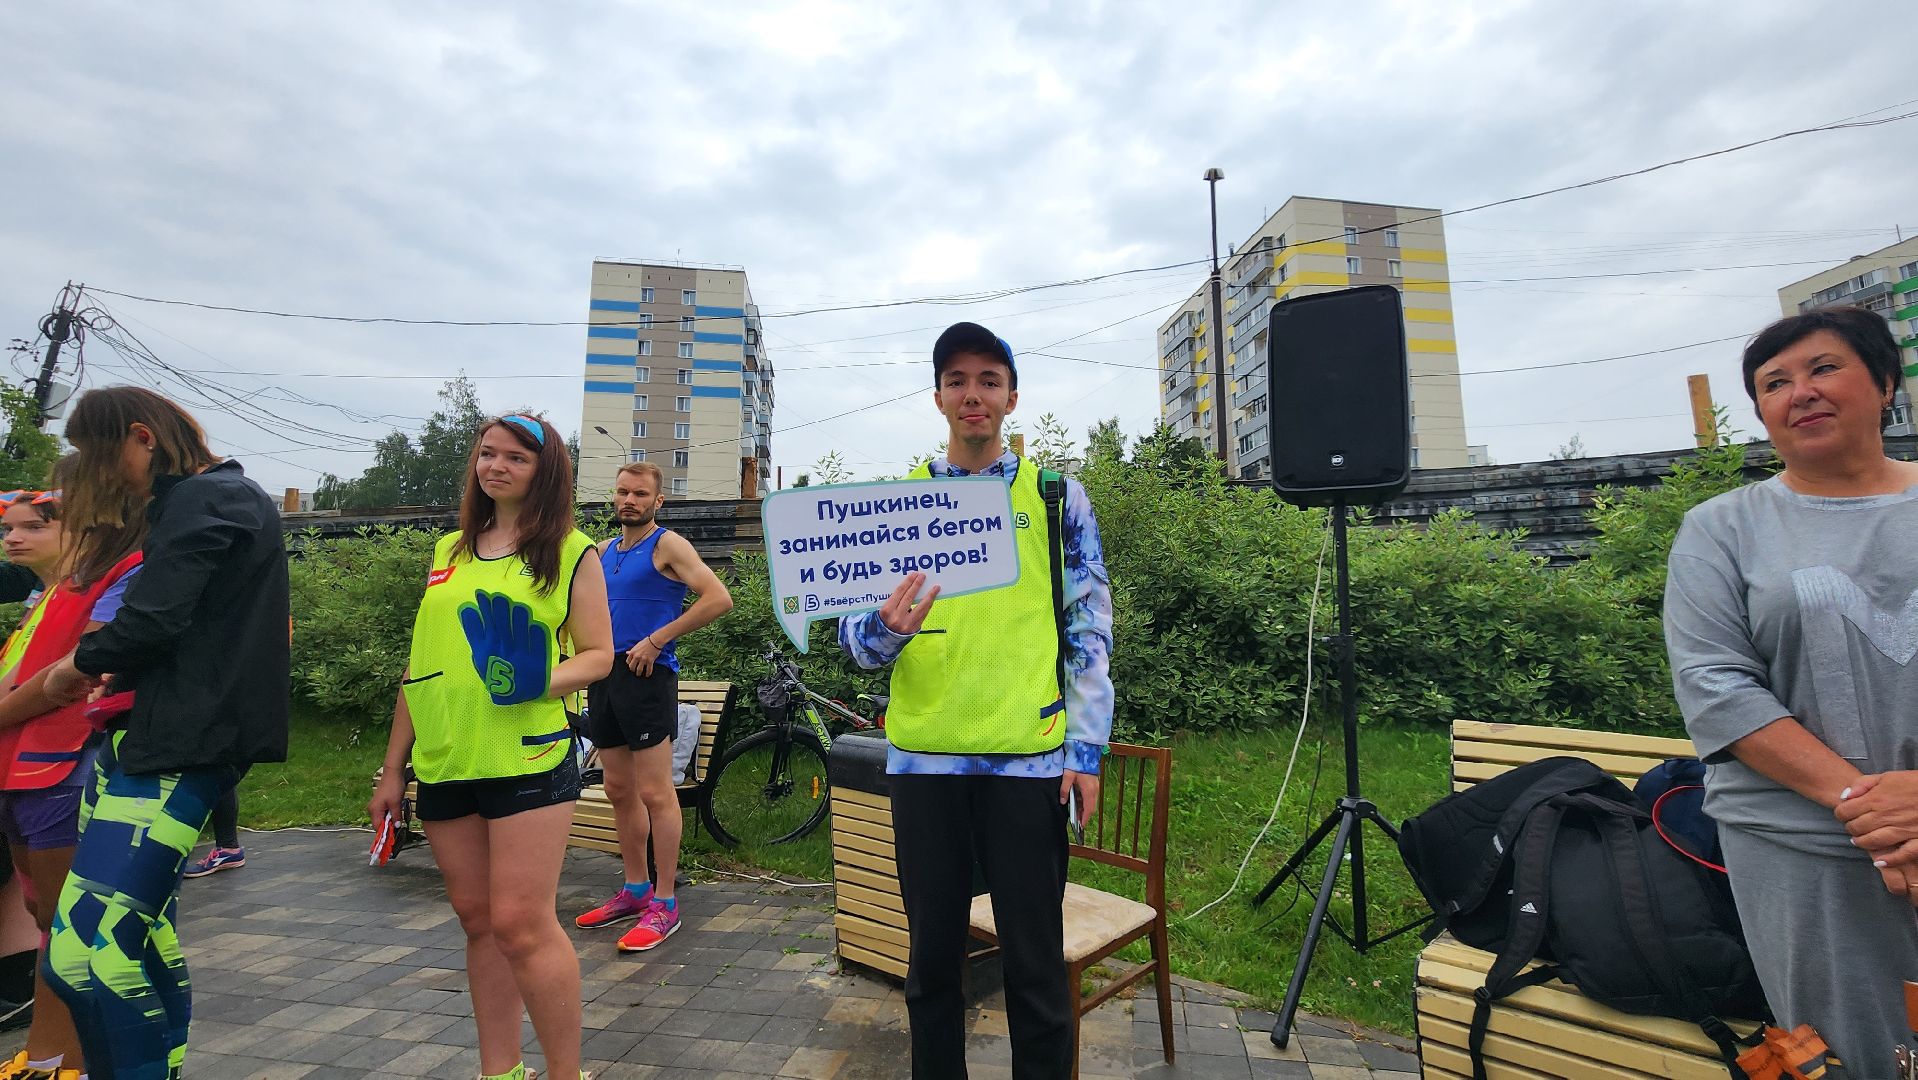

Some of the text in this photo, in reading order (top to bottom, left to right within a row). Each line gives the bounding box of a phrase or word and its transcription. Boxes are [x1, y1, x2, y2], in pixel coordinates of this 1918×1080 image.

[817, 493, 959, 523] Пушкинец,
[779, 516, 1002, 555] занимайся бегом
[800, 542, 988, 584] и будь здоров!
